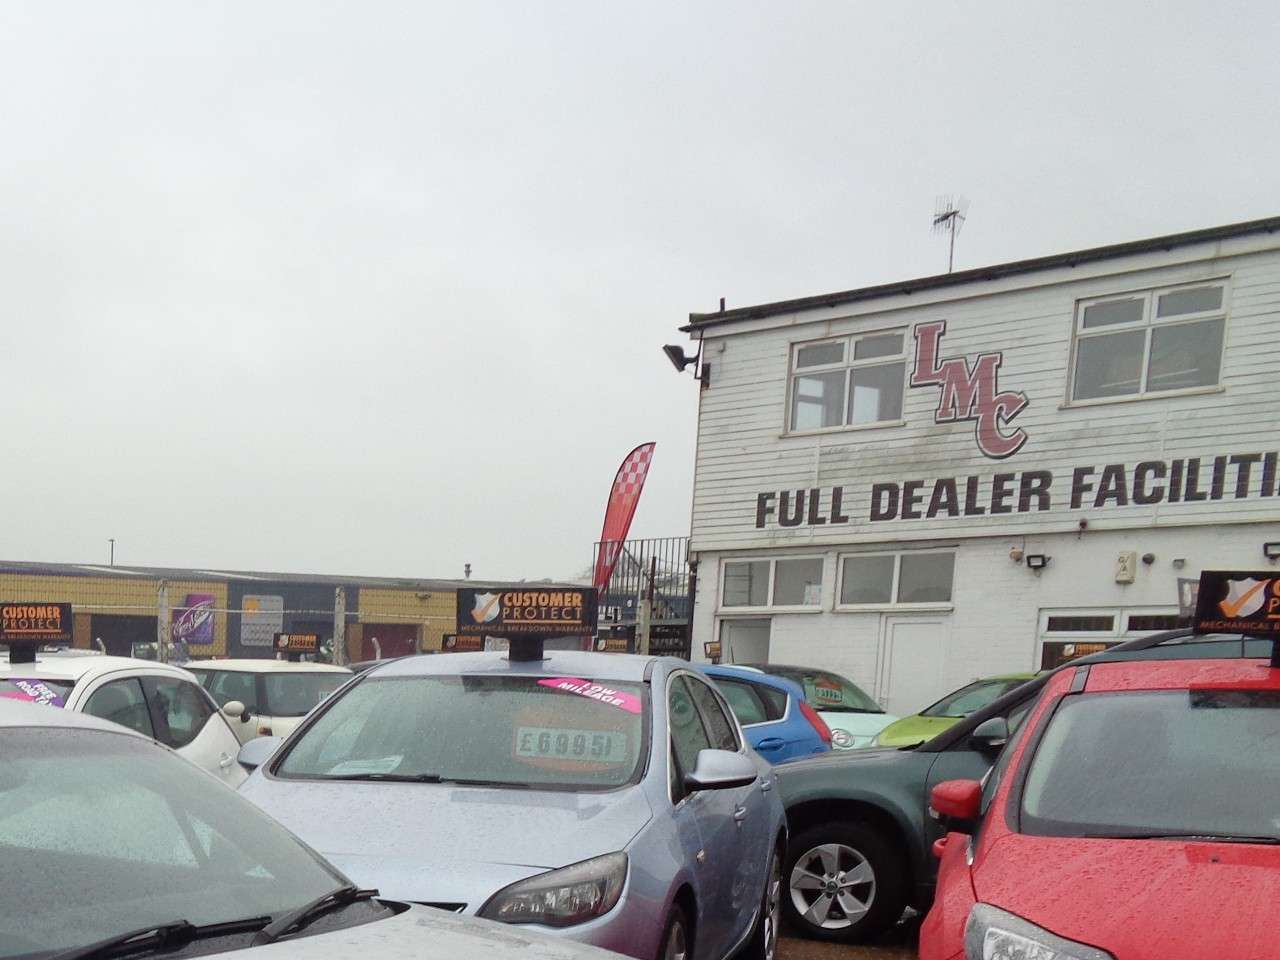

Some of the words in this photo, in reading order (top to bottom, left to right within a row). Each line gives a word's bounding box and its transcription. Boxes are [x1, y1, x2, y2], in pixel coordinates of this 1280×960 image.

[910, 320, 1029, 459] LMC
[756, 486, 849, 528] FULL
[869, 470, 1054, 522] DEALER
[504, 592, 582, 606] CUSTOMER
[2, 606, 61, 618] CUSTOMER
[503, 607, 582, 619] PROTECT
[3, 619, 61, 629] PROTECT
[557, 682, 625, 706] MILEAGE
[582, 682, 618, 696] LOW
